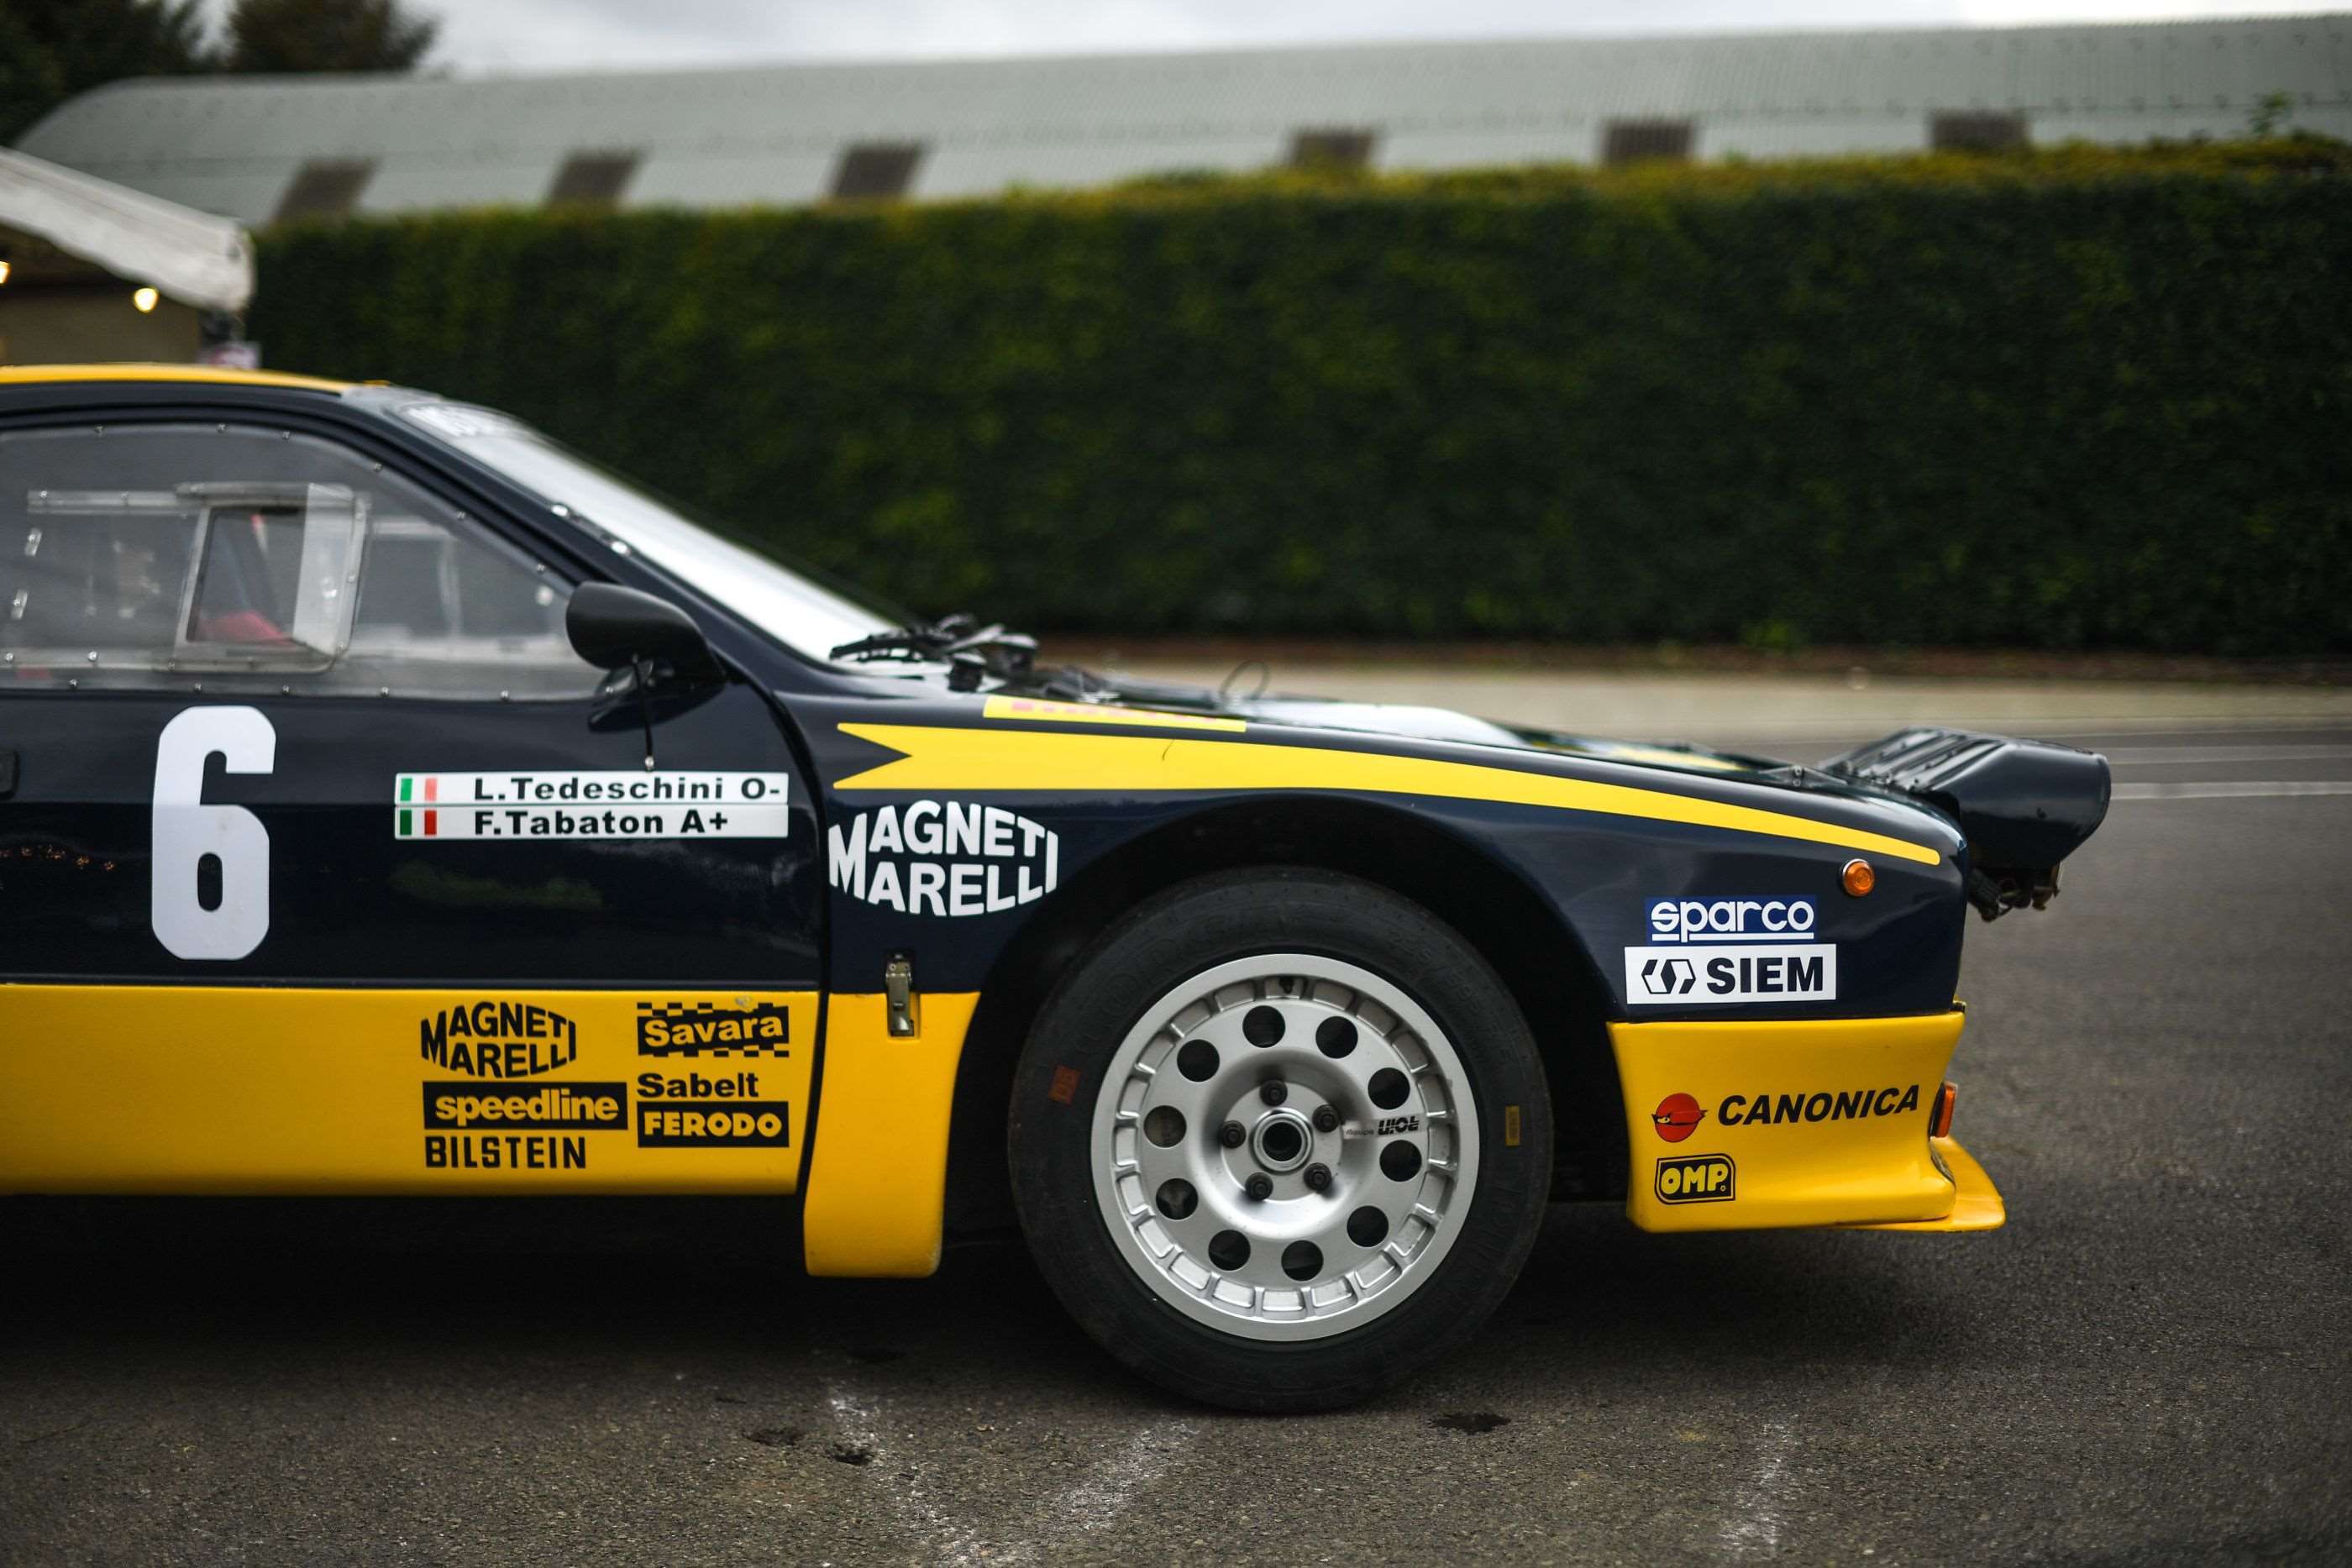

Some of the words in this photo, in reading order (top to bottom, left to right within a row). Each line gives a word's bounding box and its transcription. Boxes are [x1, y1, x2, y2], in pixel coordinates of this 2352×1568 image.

[474, 777, 723, 801] L.Tedeschini
[741, 777, 780, 800] O-
[152, 705, 276, 960] 6
[475, 810, 664, 836] F.Tabaton
[680, 809, 728, 834] A+
[828, 800, 1058, 900] MAGNETI
[828, 812, 1058, 916] MARELLI
[1651, 901, 1814, 942] sparco
[1706, 957, 1824, 994] SIEM
[421, 1001, 577, 1063] MAGNETI
[421, 1009, 577, 1078] MARELLI
[644, 1015, 784, 1047] Savara
[637, 1072, 759, 1099] Sabelt
[435, 1088, 619, 1126] speedline
[643, 1111, 782, 1137] FERODO
[1718, 1084, 1919, 1126] CANONICA
[425, 1136, 586, 1169] BILSTEIN
